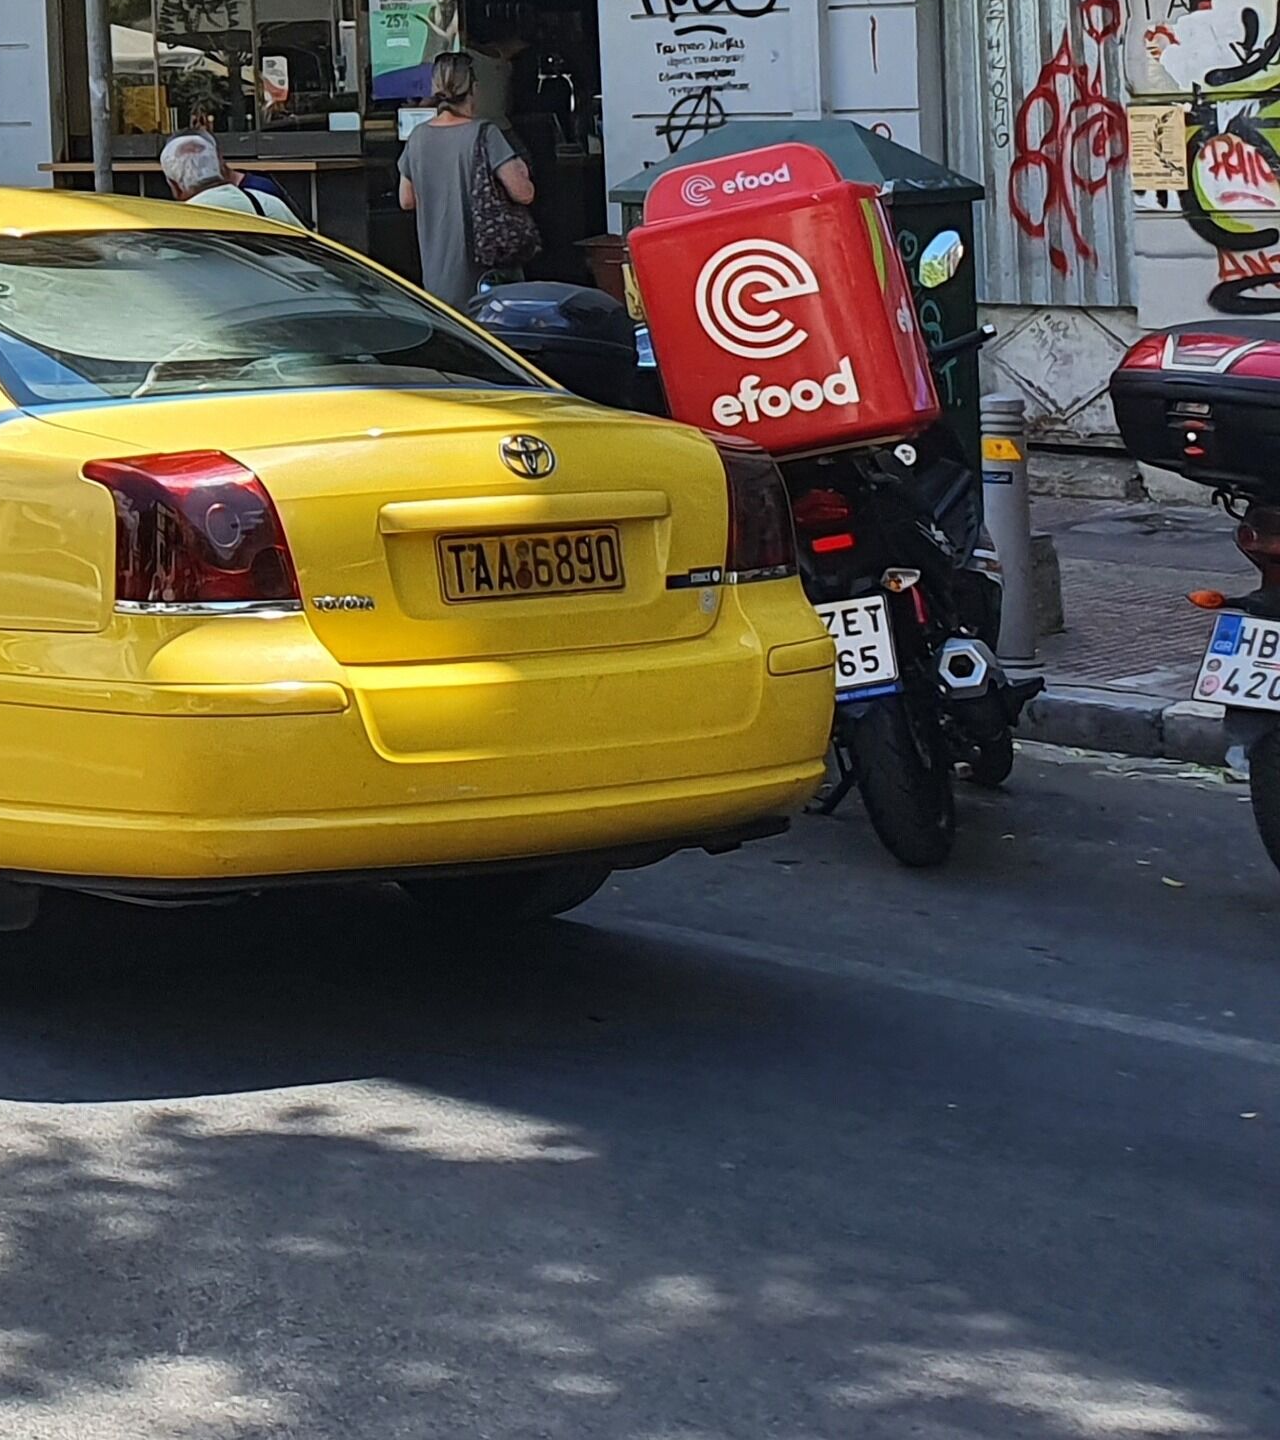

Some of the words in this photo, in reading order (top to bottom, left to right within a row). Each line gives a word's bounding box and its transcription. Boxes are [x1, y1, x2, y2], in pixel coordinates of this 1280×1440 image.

[722, 163, 792, 195] efood
[712, 356, 860, 427] efood
[312, 595, 377, 612] TOYOTA
